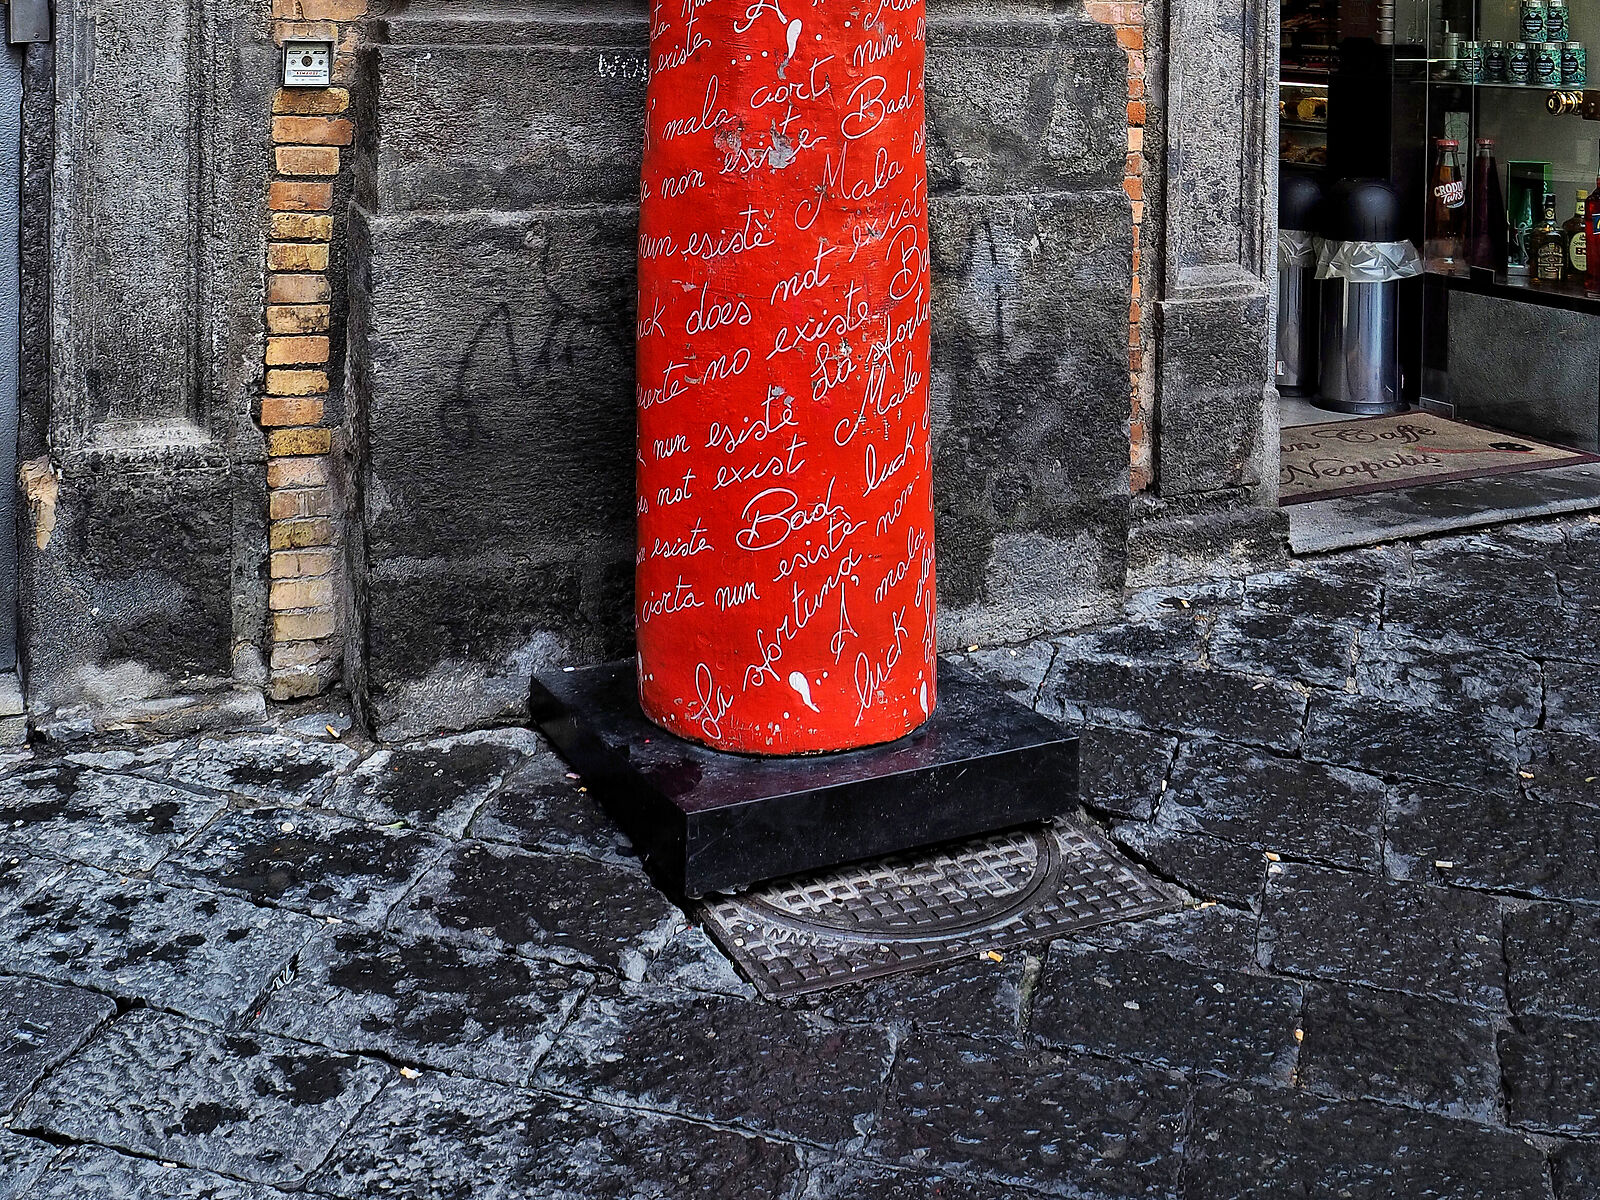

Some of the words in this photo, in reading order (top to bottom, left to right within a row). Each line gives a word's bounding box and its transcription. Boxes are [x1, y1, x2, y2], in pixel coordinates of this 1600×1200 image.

[661, 168, 706, 200] non
[719, 103, 828, 175] esite
[841, 69, 916, 140] Bad
[662, 74, 737, 141] mala
[853, 32, 903, 68] nun
[795, 141, 904, 231] Mala
[686, 281, 752, 335] does
[770, 241, 838, 306] not
[703, 347, 751, 386] no
[765, 280, 869, 361] existe
[650, 517, 714, 559] esiste
[735, 476, 845, 551] Bad
[862, 421, 916, 498] luck
[652, 434, 691, 461] nun
[656, 467, 697, 507] not
[712, 433, 808, 491] exist
[715, 581, 760, 612] nun
[874, 526, 926, 604] mala
[742, 548, 863, 692] sfortuna
[854, 605, 909, 727] luck
